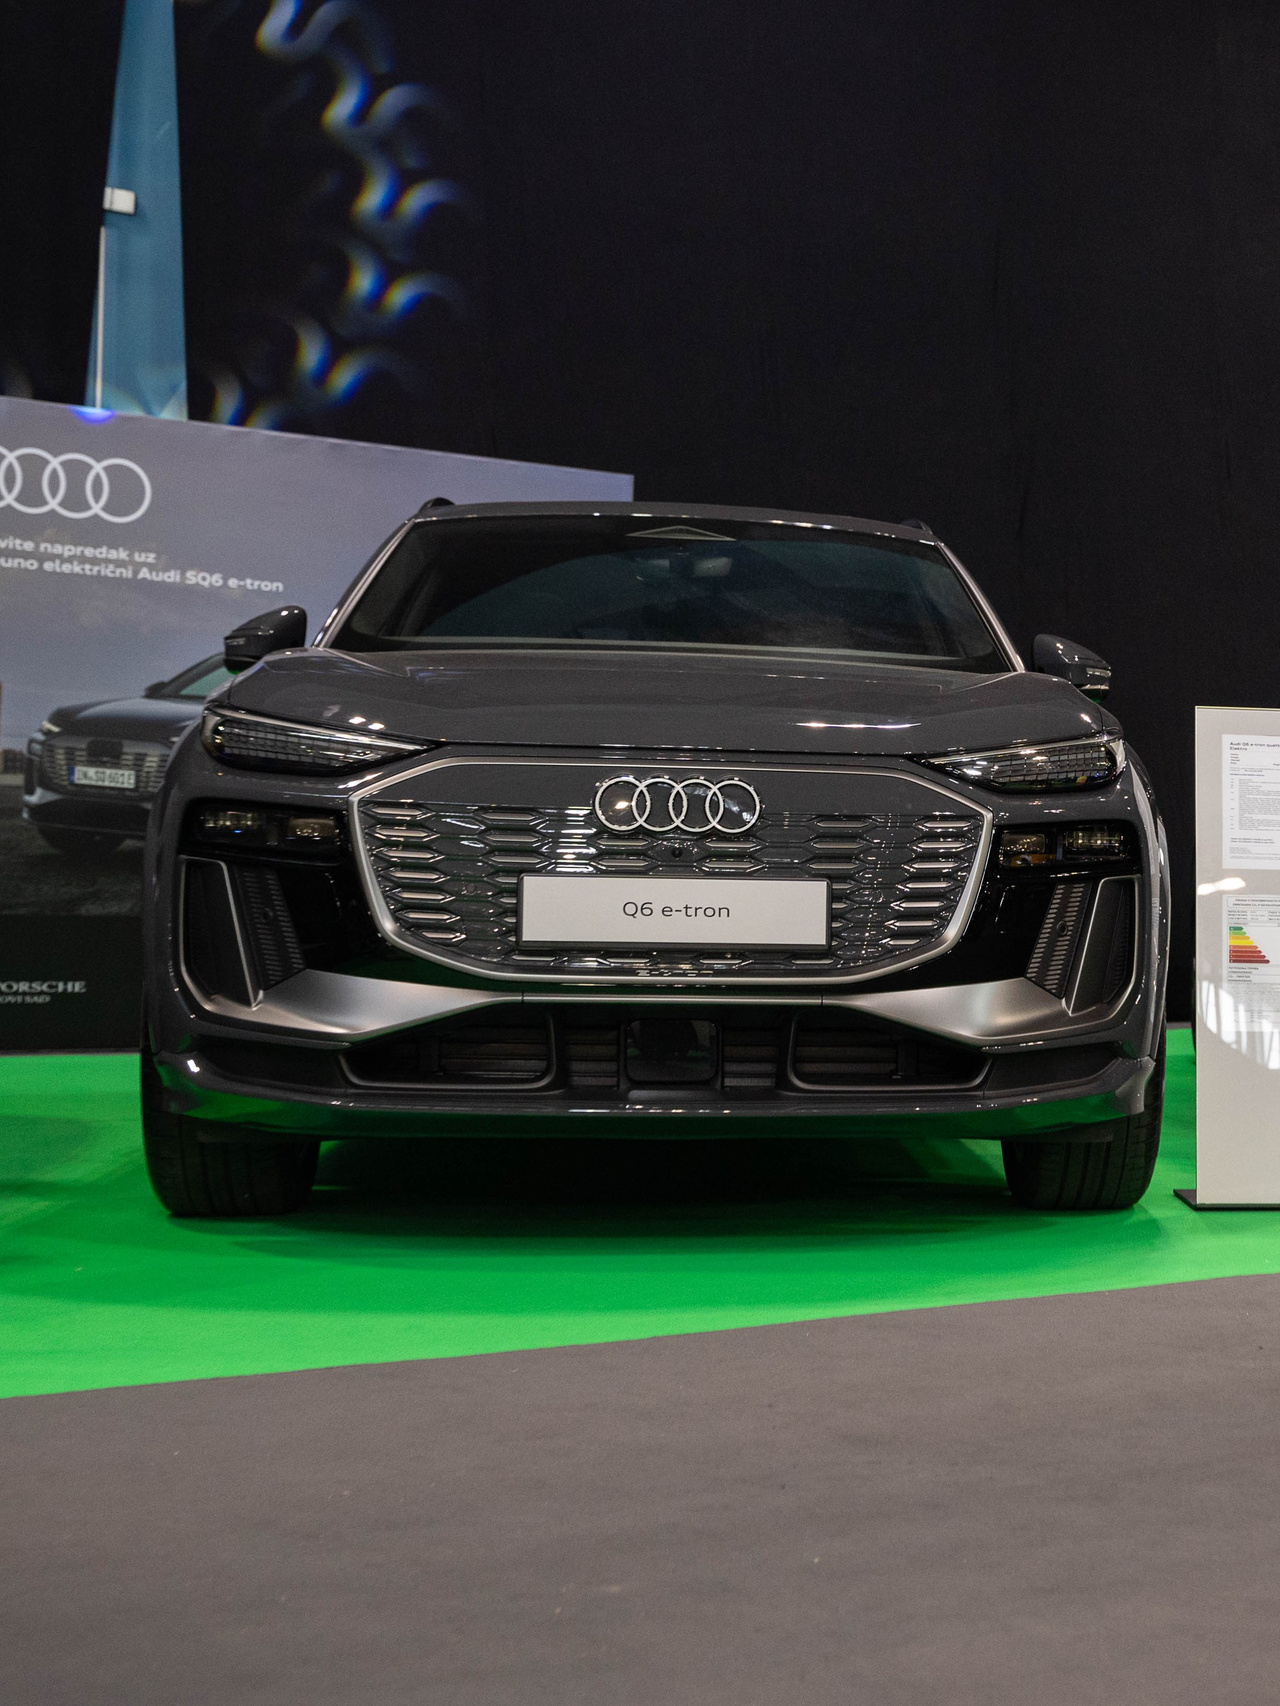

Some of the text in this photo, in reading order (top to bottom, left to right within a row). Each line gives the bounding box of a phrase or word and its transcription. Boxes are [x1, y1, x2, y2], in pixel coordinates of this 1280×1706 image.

[40, 542, 130, 561] napredak
[134, 551, 157, 563] uz
[43, 559, 133, 579] električni
[137, 567, 181, 583] Audi
[185, 570, 223, 588] SQ6
[227, 577, 284, 592] e-tron
[622, 901, 730, 919] Q6 e-tron
[0, 981, 87, 993] ORSCHE
